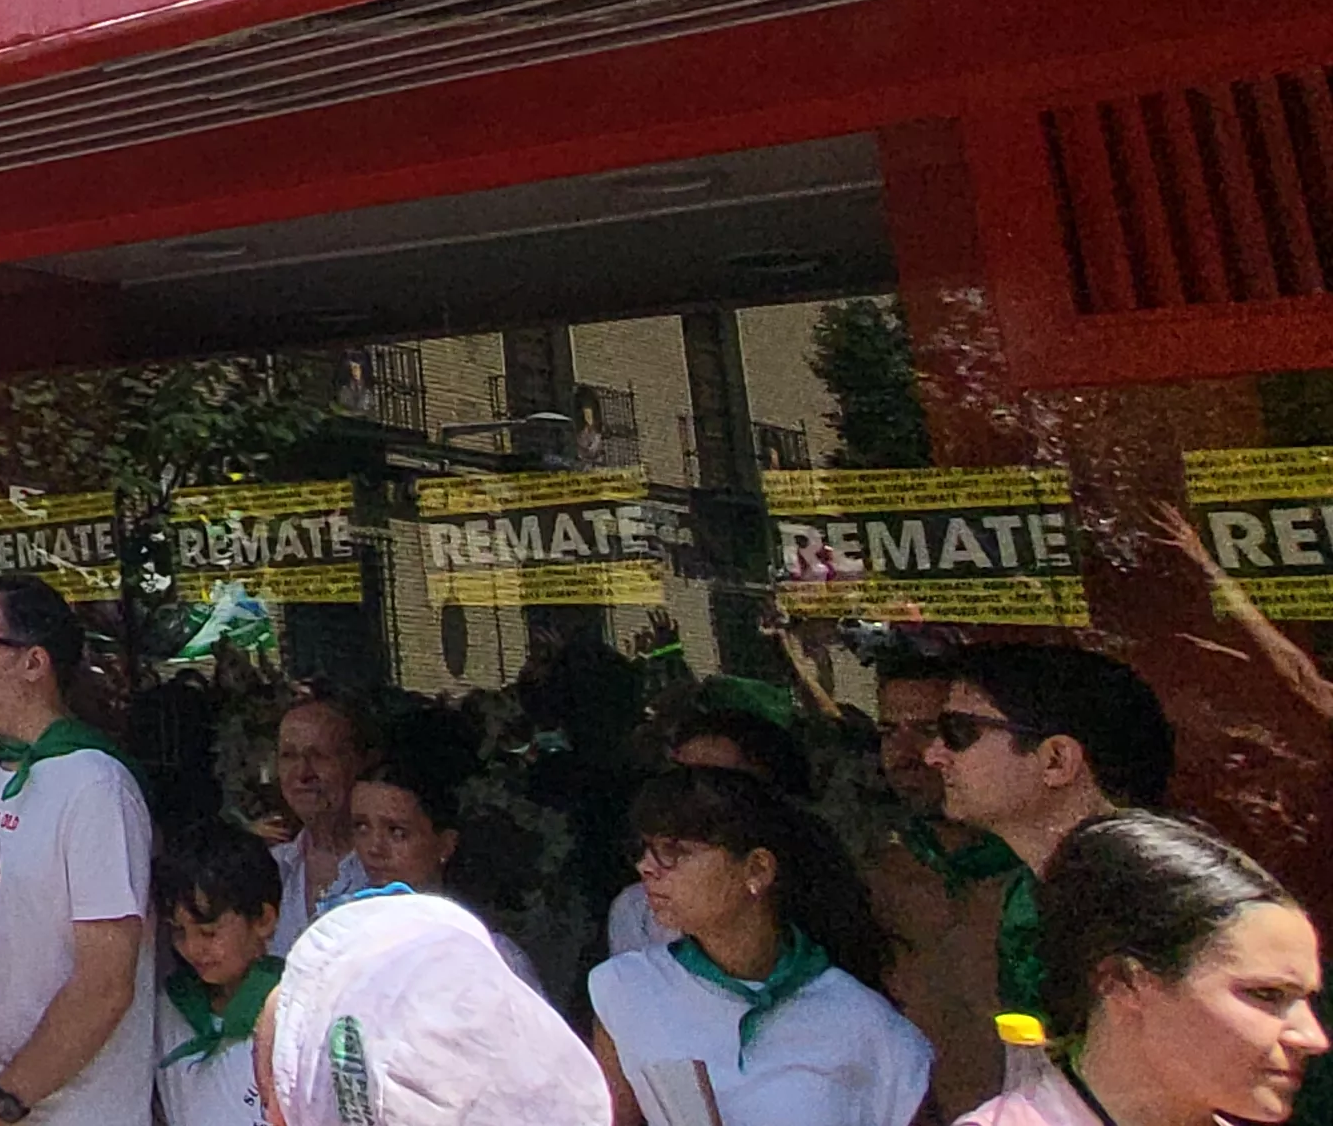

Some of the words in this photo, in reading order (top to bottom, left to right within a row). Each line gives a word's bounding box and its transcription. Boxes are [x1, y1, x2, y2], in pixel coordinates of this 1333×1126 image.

[178, 515, 354, 568] REMATE
[428, 506, 650, 568] REMATE
[779, 513, 1072, 574] REMATE
[1207, 505, 1333, 569] RE
